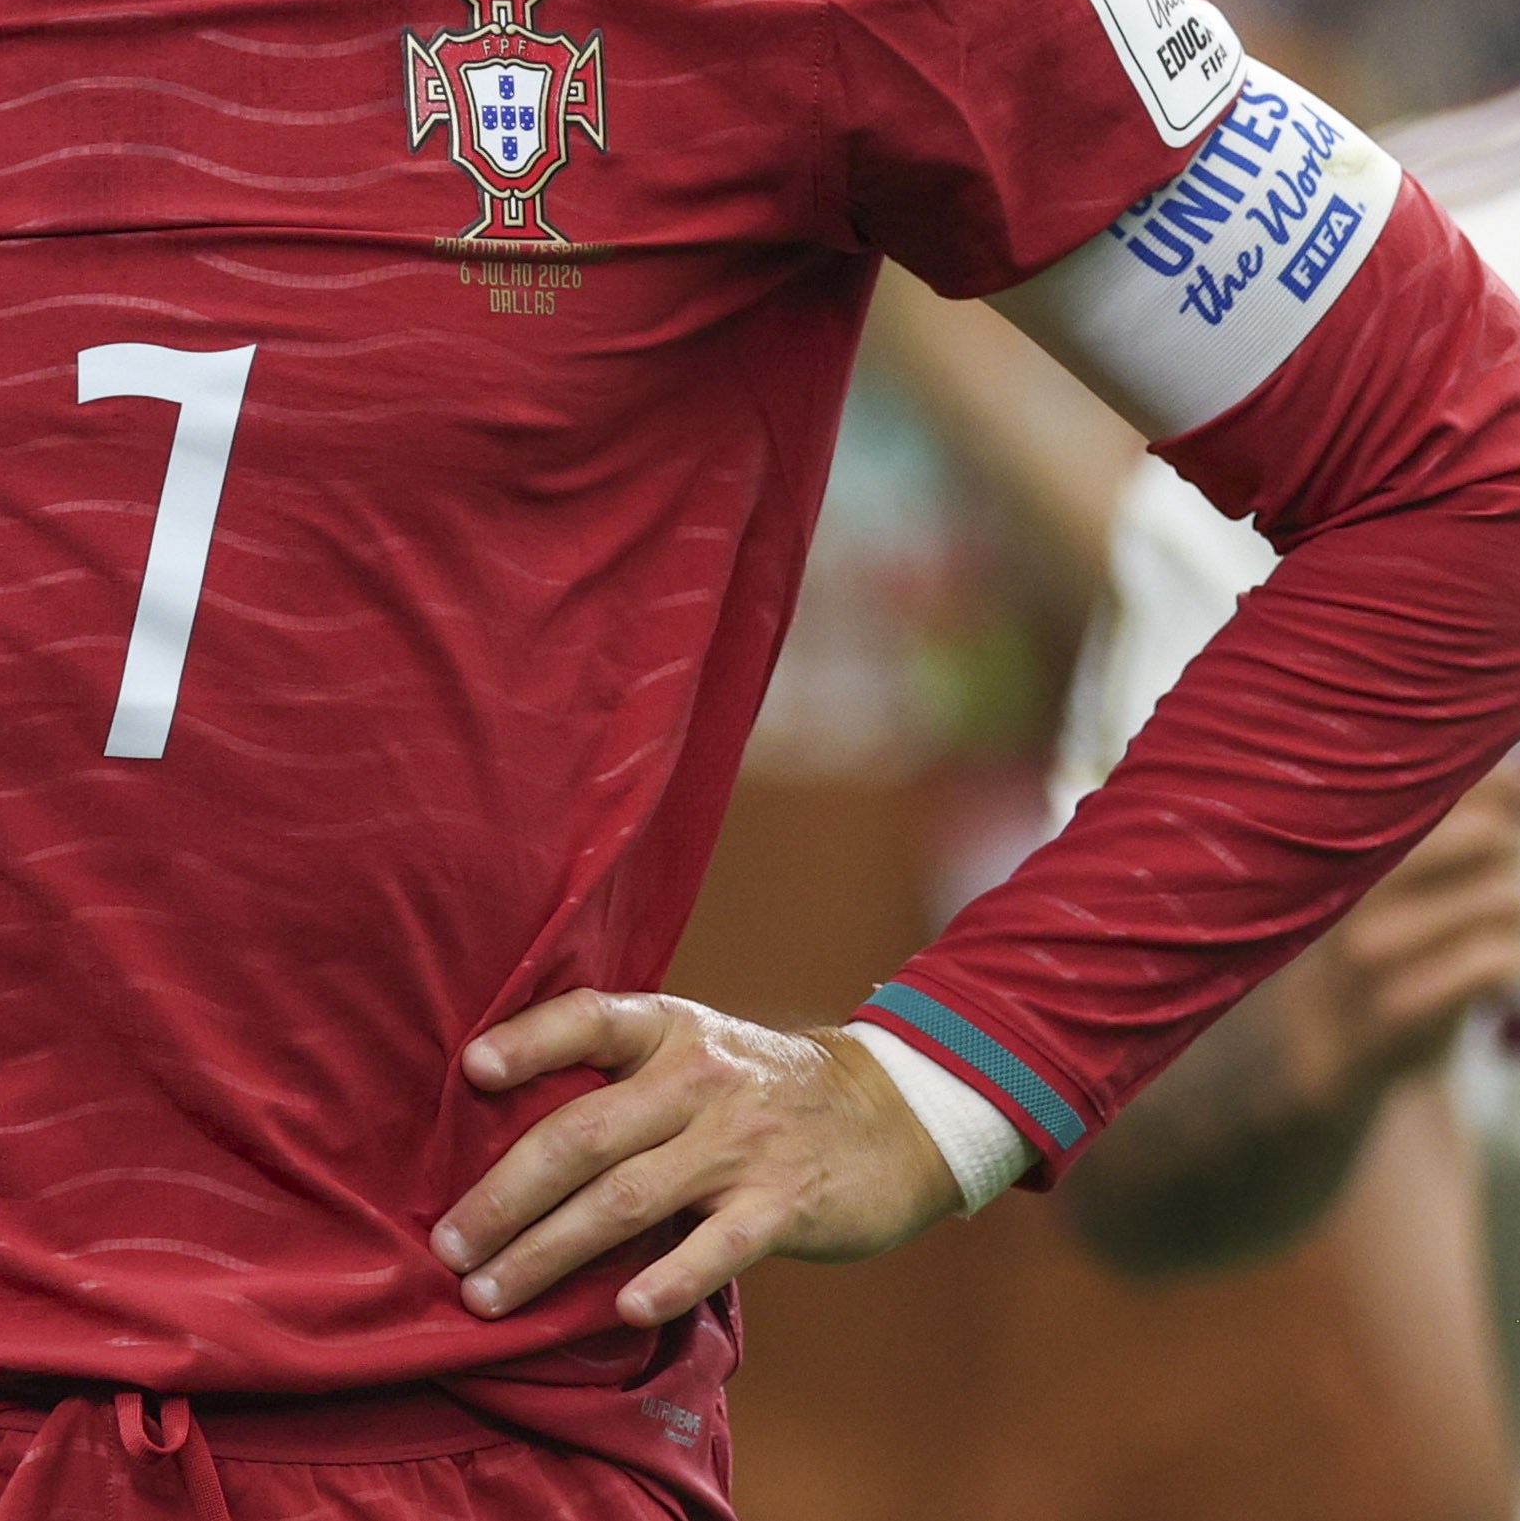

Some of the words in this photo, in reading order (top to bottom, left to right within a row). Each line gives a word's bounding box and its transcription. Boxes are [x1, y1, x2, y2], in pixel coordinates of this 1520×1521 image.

[1200, 43, 1228, 82] FIFA
[1127, 80, 1289, 277] UNITES
[1179, 245, 1263, 326] the
[1246, 103, 1345, 245] World
[460, 261, 471, 285] 6
[478, 262, 532, 288] JULHO
[538, 264, 582, 289] 2026
[1289, 208, 1355, 290] FIFA
[490, 288, 556, 316] DALLAS
[77, 342, 258, 760] 7
